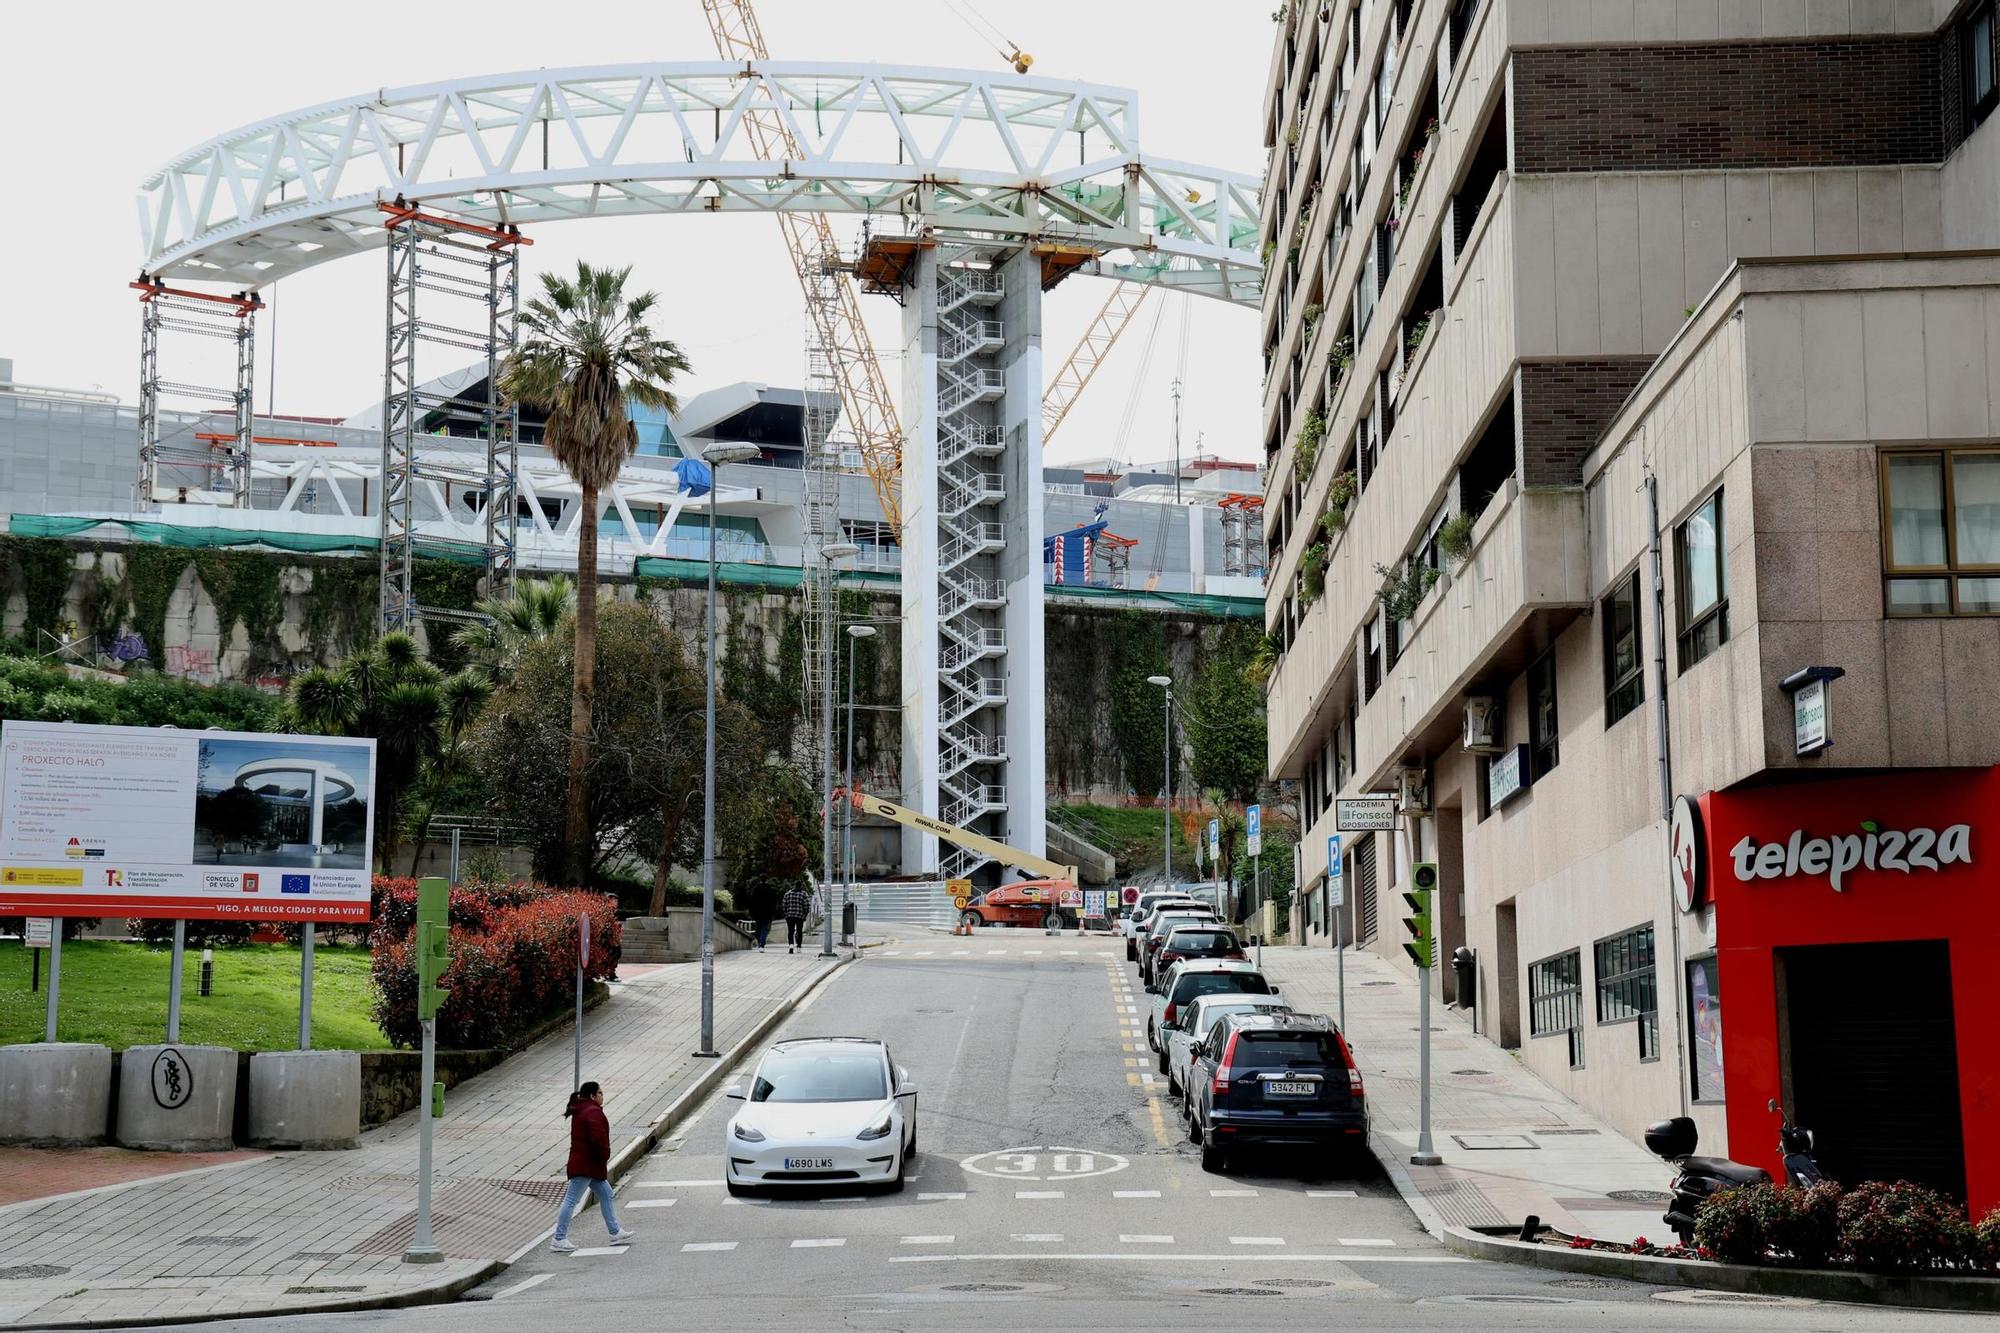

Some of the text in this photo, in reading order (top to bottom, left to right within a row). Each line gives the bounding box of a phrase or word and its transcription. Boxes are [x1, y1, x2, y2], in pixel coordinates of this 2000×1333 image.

[22, 754, 104, 766] PROXECTO HALO
[915, 818, 951, 834] RIWAL.COM
[1249, 810, 1256, 832] P
[1330, 840, 1338, 872] P
[1729, 821, 1972, 892] telepizza
[216, 904, 242, 913] VIGO,
[1271, 1083, 1312, 1092] 5342 FKL
[790, 1159, 833, 1168] 4690 LMS
[994, 1154, 1094, 1173] 30
